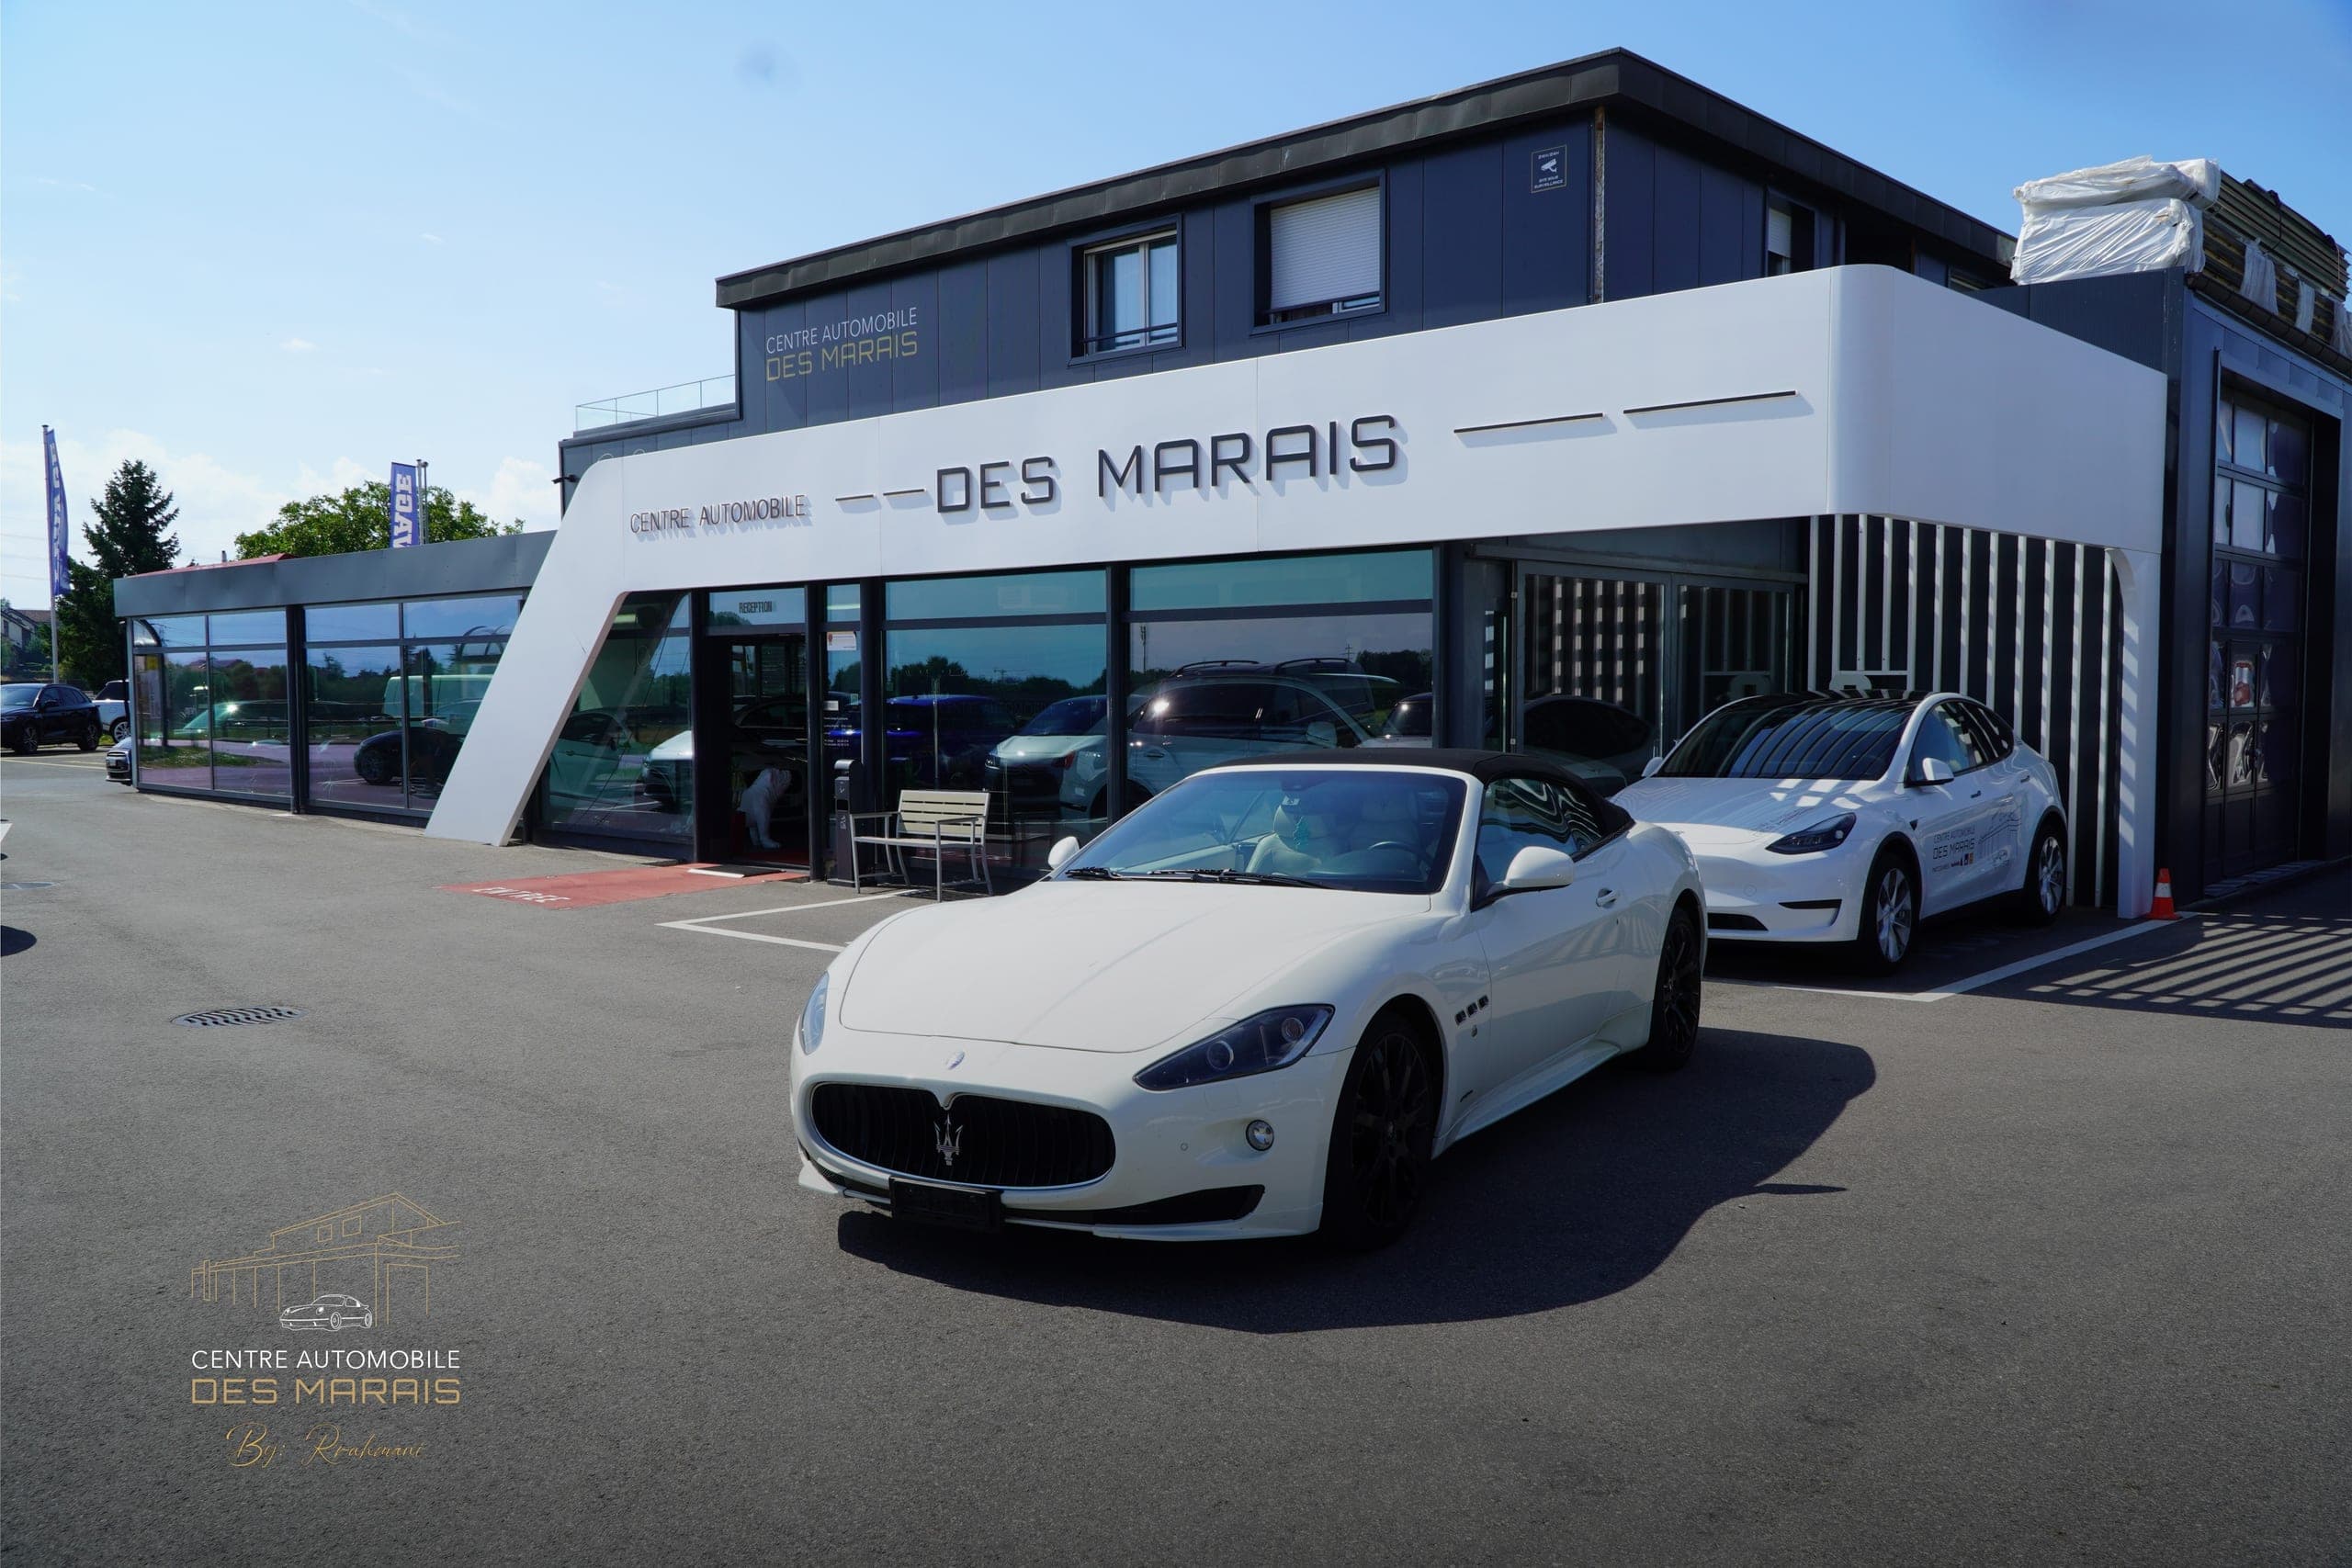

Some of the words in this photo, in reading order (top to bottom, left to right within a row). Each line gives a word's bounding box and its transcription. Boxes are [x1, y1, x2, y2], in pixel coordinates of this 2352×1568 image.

[766, 328, 818, 355] CENTRE
[821, 307, 918, 343] AUTOMOBILE
[766, 351, 813, 381] DES
[821, 331, 918, 372] MARAIS
[936, 456, 1055, 514] DES
[1098, 414, 1396, 499] MARAIS
[630, 508, 690, 534] CENTRE
[699, 494, 806, 526] AUTOMOBILE
[739, 600, 773, 615] RECEPTION
